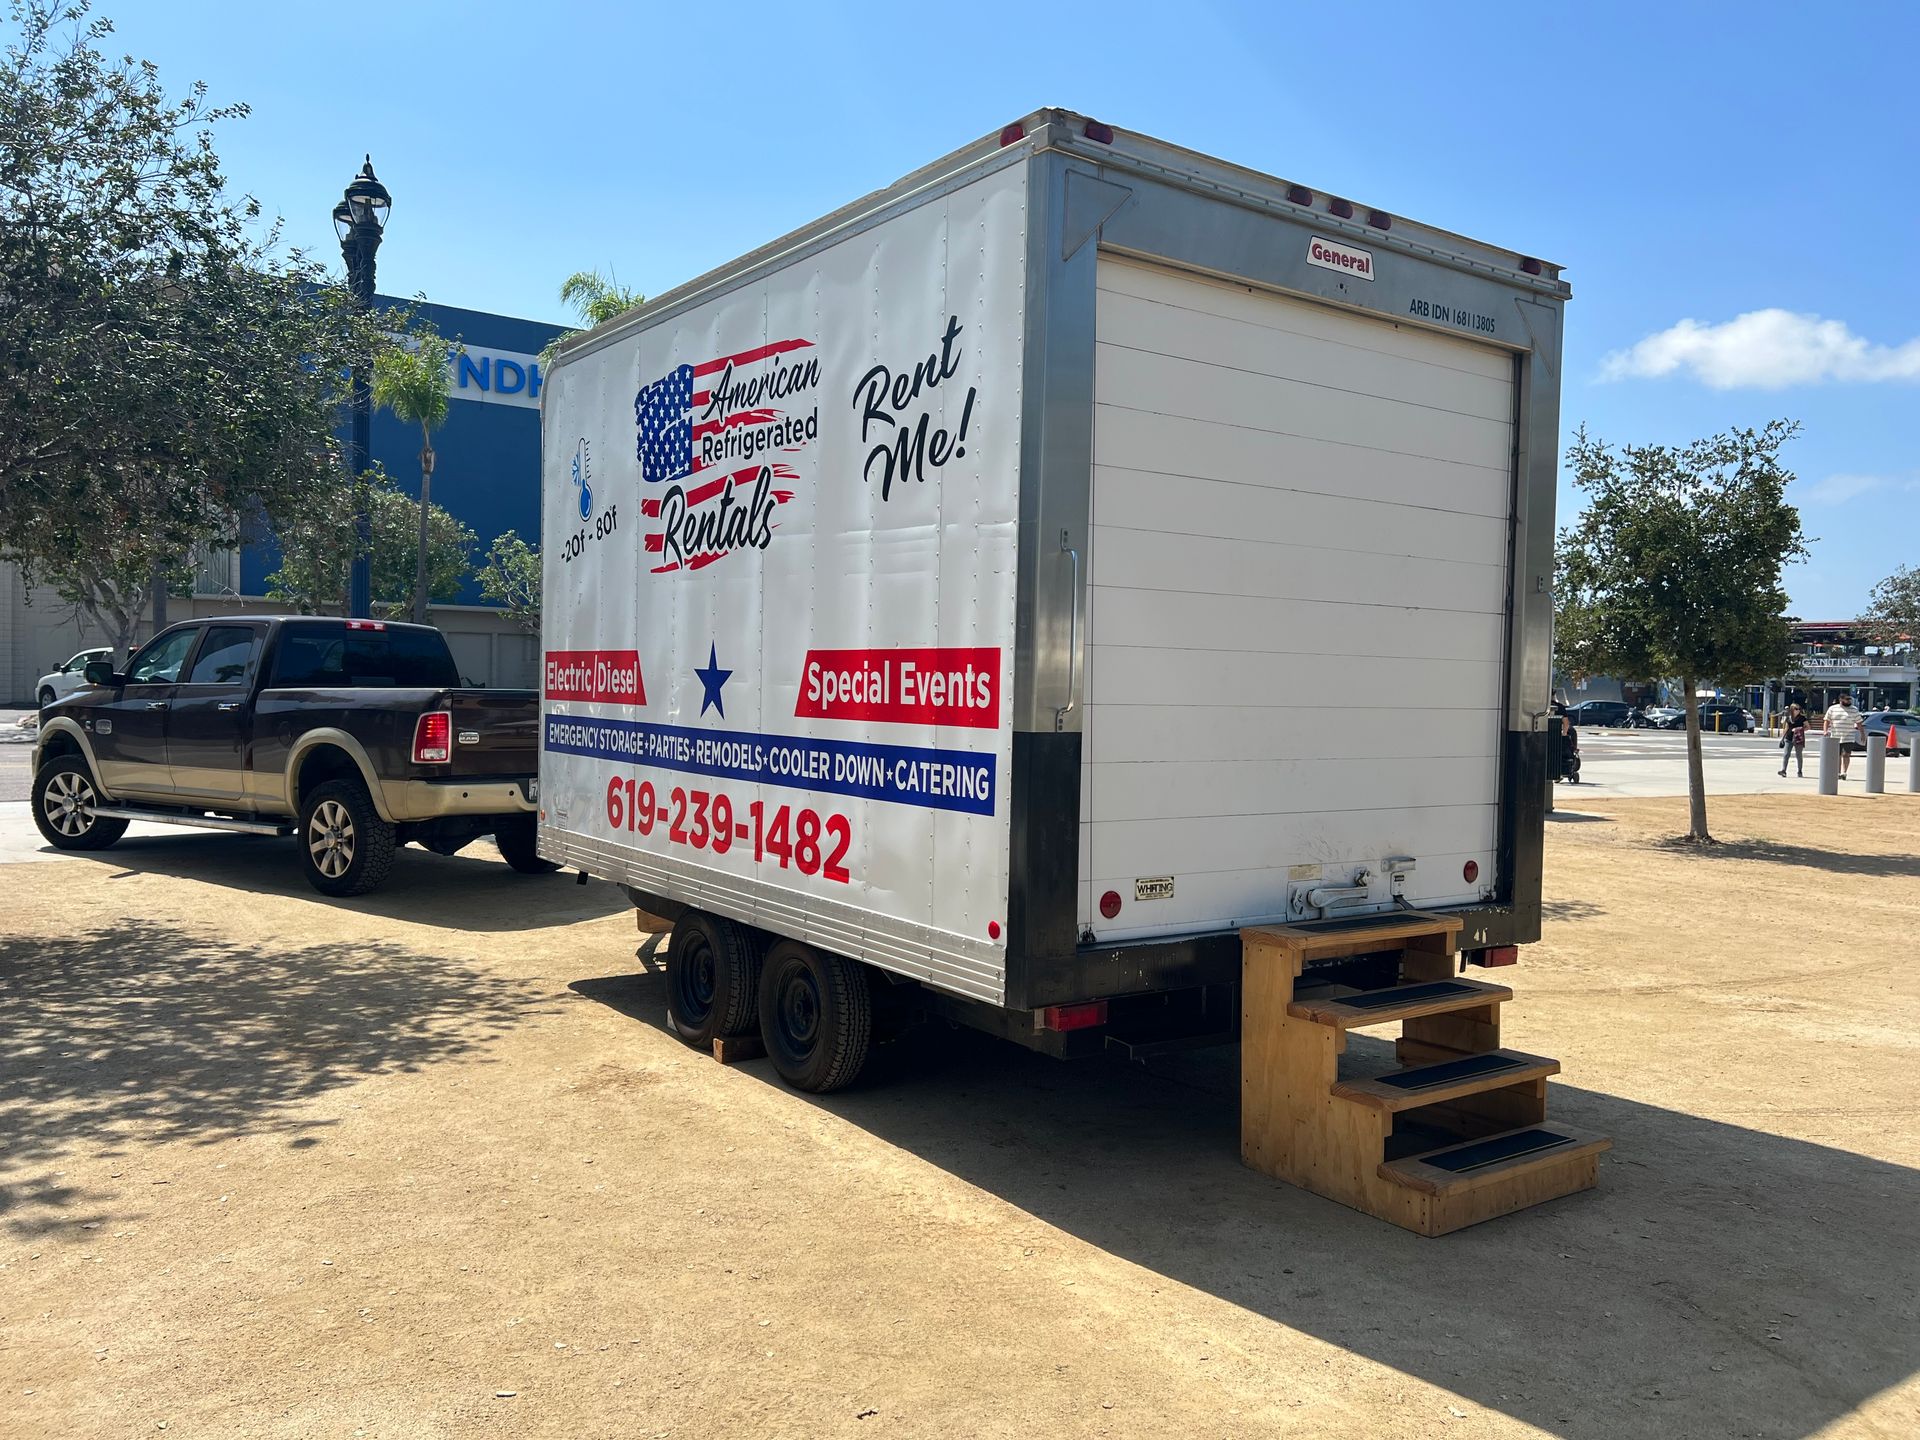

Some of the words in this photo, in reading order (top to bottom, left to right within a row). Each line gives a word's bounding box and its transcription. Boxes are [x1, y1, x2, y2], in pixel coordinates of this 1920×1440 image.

[1311, 243, 1370, 274] General
[1409, 299, 1429, 317] ARB
[1431, 304, 1450, 322] IDN
[1452, 309, 1495, 333] 168113805
[701, 355, 822, 423] American
[853, 315, 963, 443] Rent
[702, 406, 818, 464] Refrigerated
[863, 387, 977, 502] Me!
[660, 466, 776, 570] Rentals
[547, 654, 638, 699] Electric/Diesel
[807, 660, 890, 710] Special
[900, 661, 991, 708] Events
[549, 723, 599, 749] EMERGENCY
[600, 728, 644, 755] STORAGE
[649, 733, 690, 762] PARTIES
[696, 739, 762, 771] REMODELS
[769, 746, 830, 780] COOLER
[834, 752, 885, 788] DOWN
[895, 759, 989, 801] CATERING
[607, 775, 851, 885] 619-239-1482
[1137, 883, 1173, 893] WHITING
